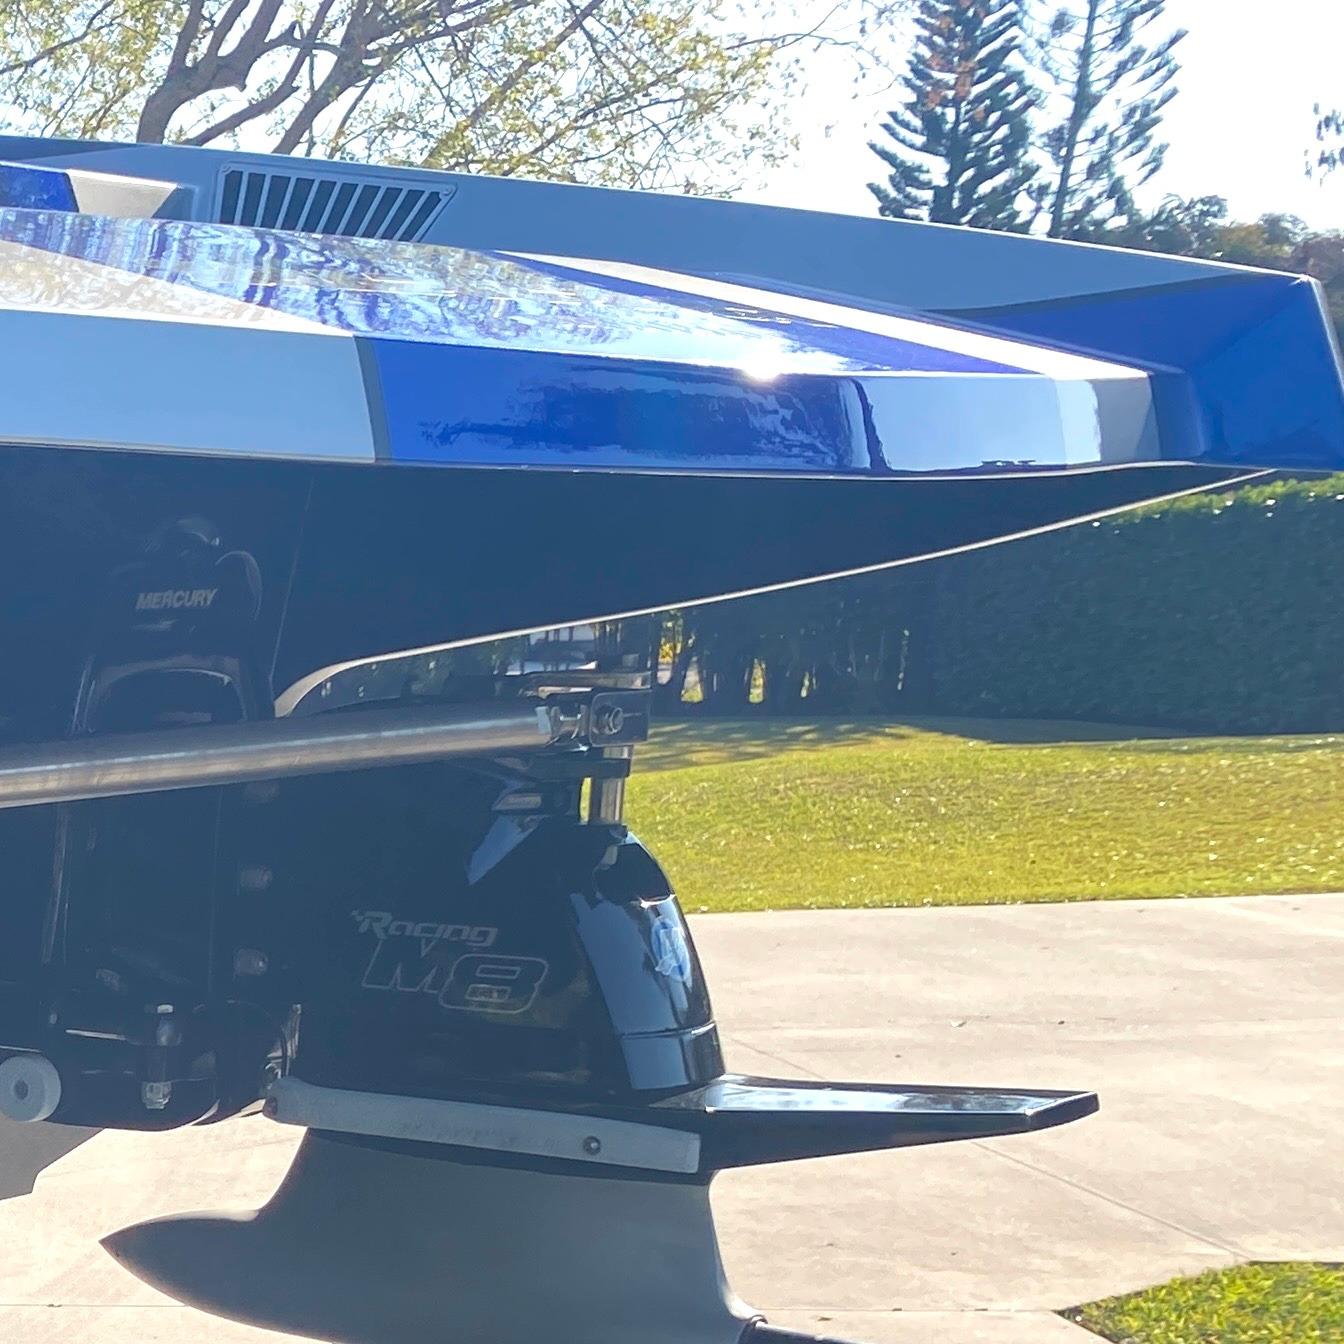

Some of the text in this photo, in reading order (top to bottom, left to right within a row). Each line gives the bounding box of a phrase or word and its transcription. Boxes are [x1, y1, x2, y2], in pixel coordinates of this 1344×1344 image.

[135, 588, 218, 609] MERCURY
[352, 910, 499, 947] Racing
[362, 938, 549, 1015] M8
